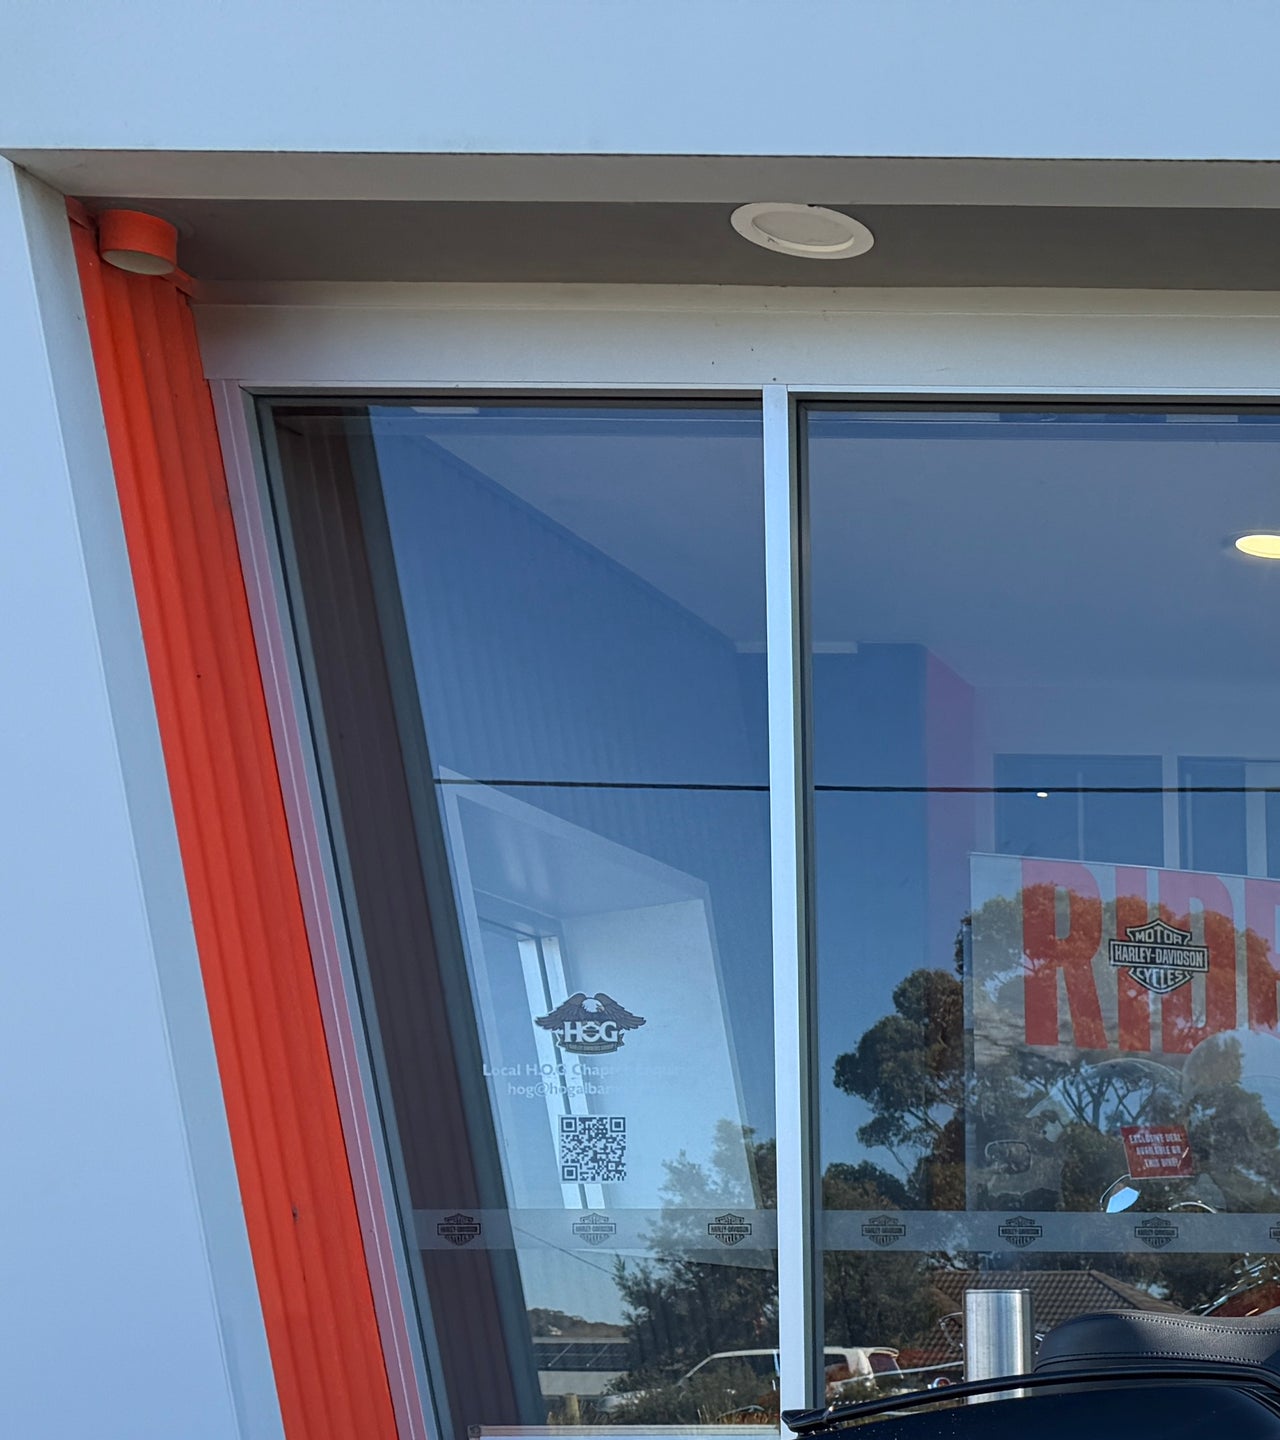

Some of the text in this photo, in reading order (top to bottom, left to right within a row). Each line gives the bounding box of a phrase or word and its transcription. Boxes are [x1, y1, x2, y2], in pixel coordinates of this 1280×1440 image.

[1135, 925, 1182, 945] MOTOR
[1114, 945, 1203, 967] HARLEY-DAVIDSON
[1136, 967, 1183, 988] CYCLES
[563, 1021, 618, 1043] HOG
[482, 1063, 521, 1077] Local
